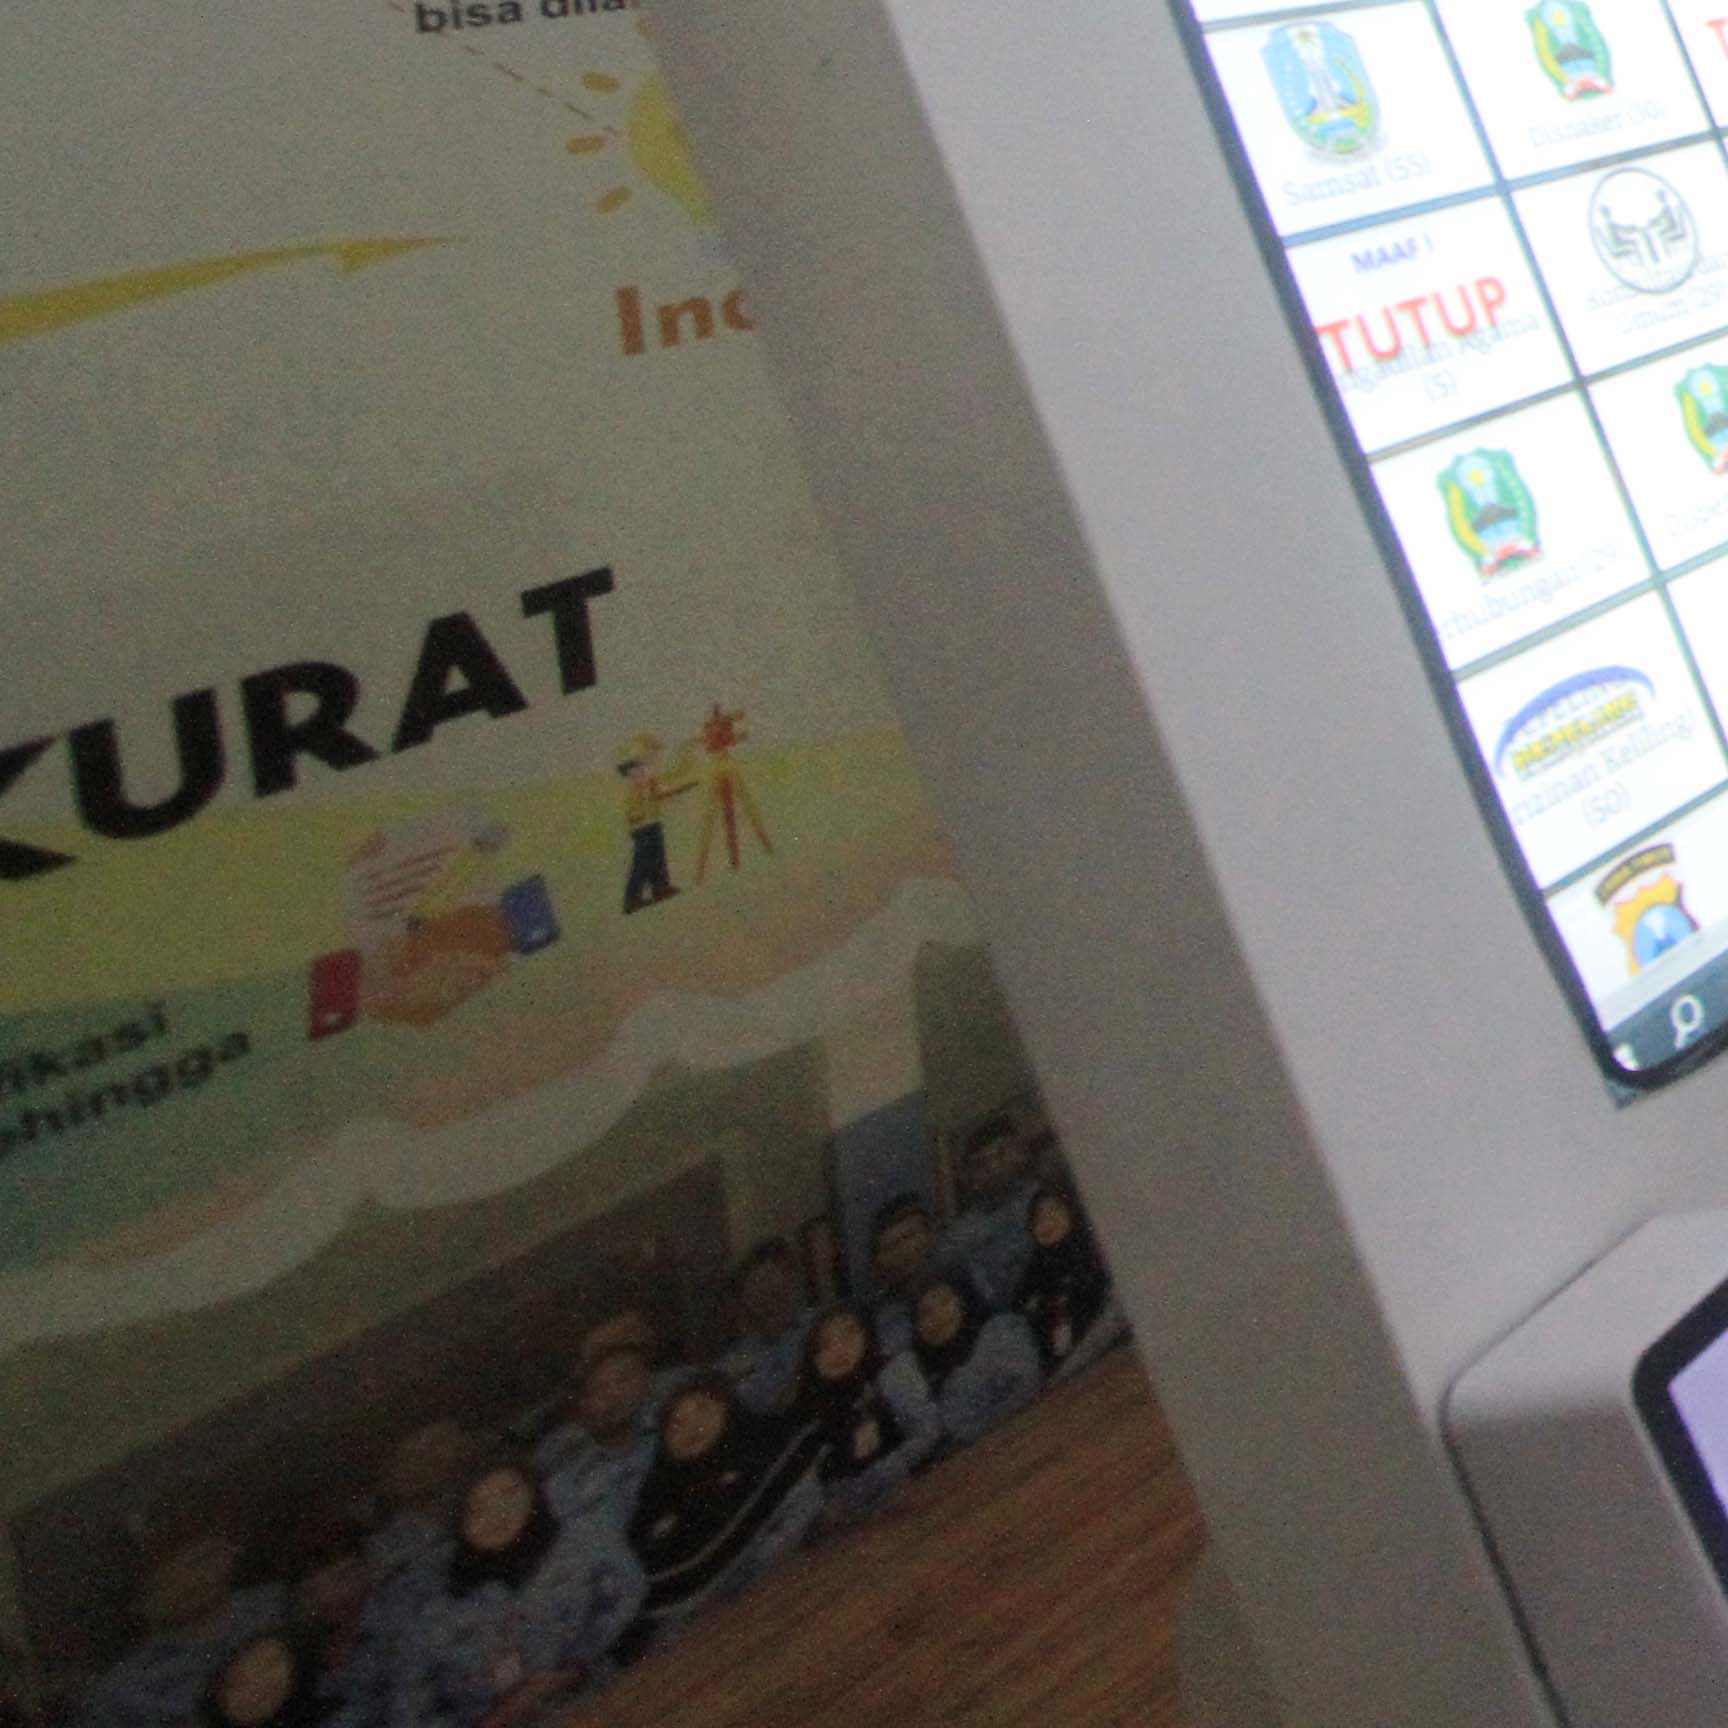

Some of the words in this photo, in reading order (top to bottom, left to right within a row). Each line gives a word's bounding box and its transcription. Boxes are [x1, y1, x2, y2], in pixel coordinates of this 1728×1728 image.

[1281, 163, 1381, 208] Samsat
[1350, 238, 1418, 274] MAAF
[1316, 276, 1508, 374] TUTUP
